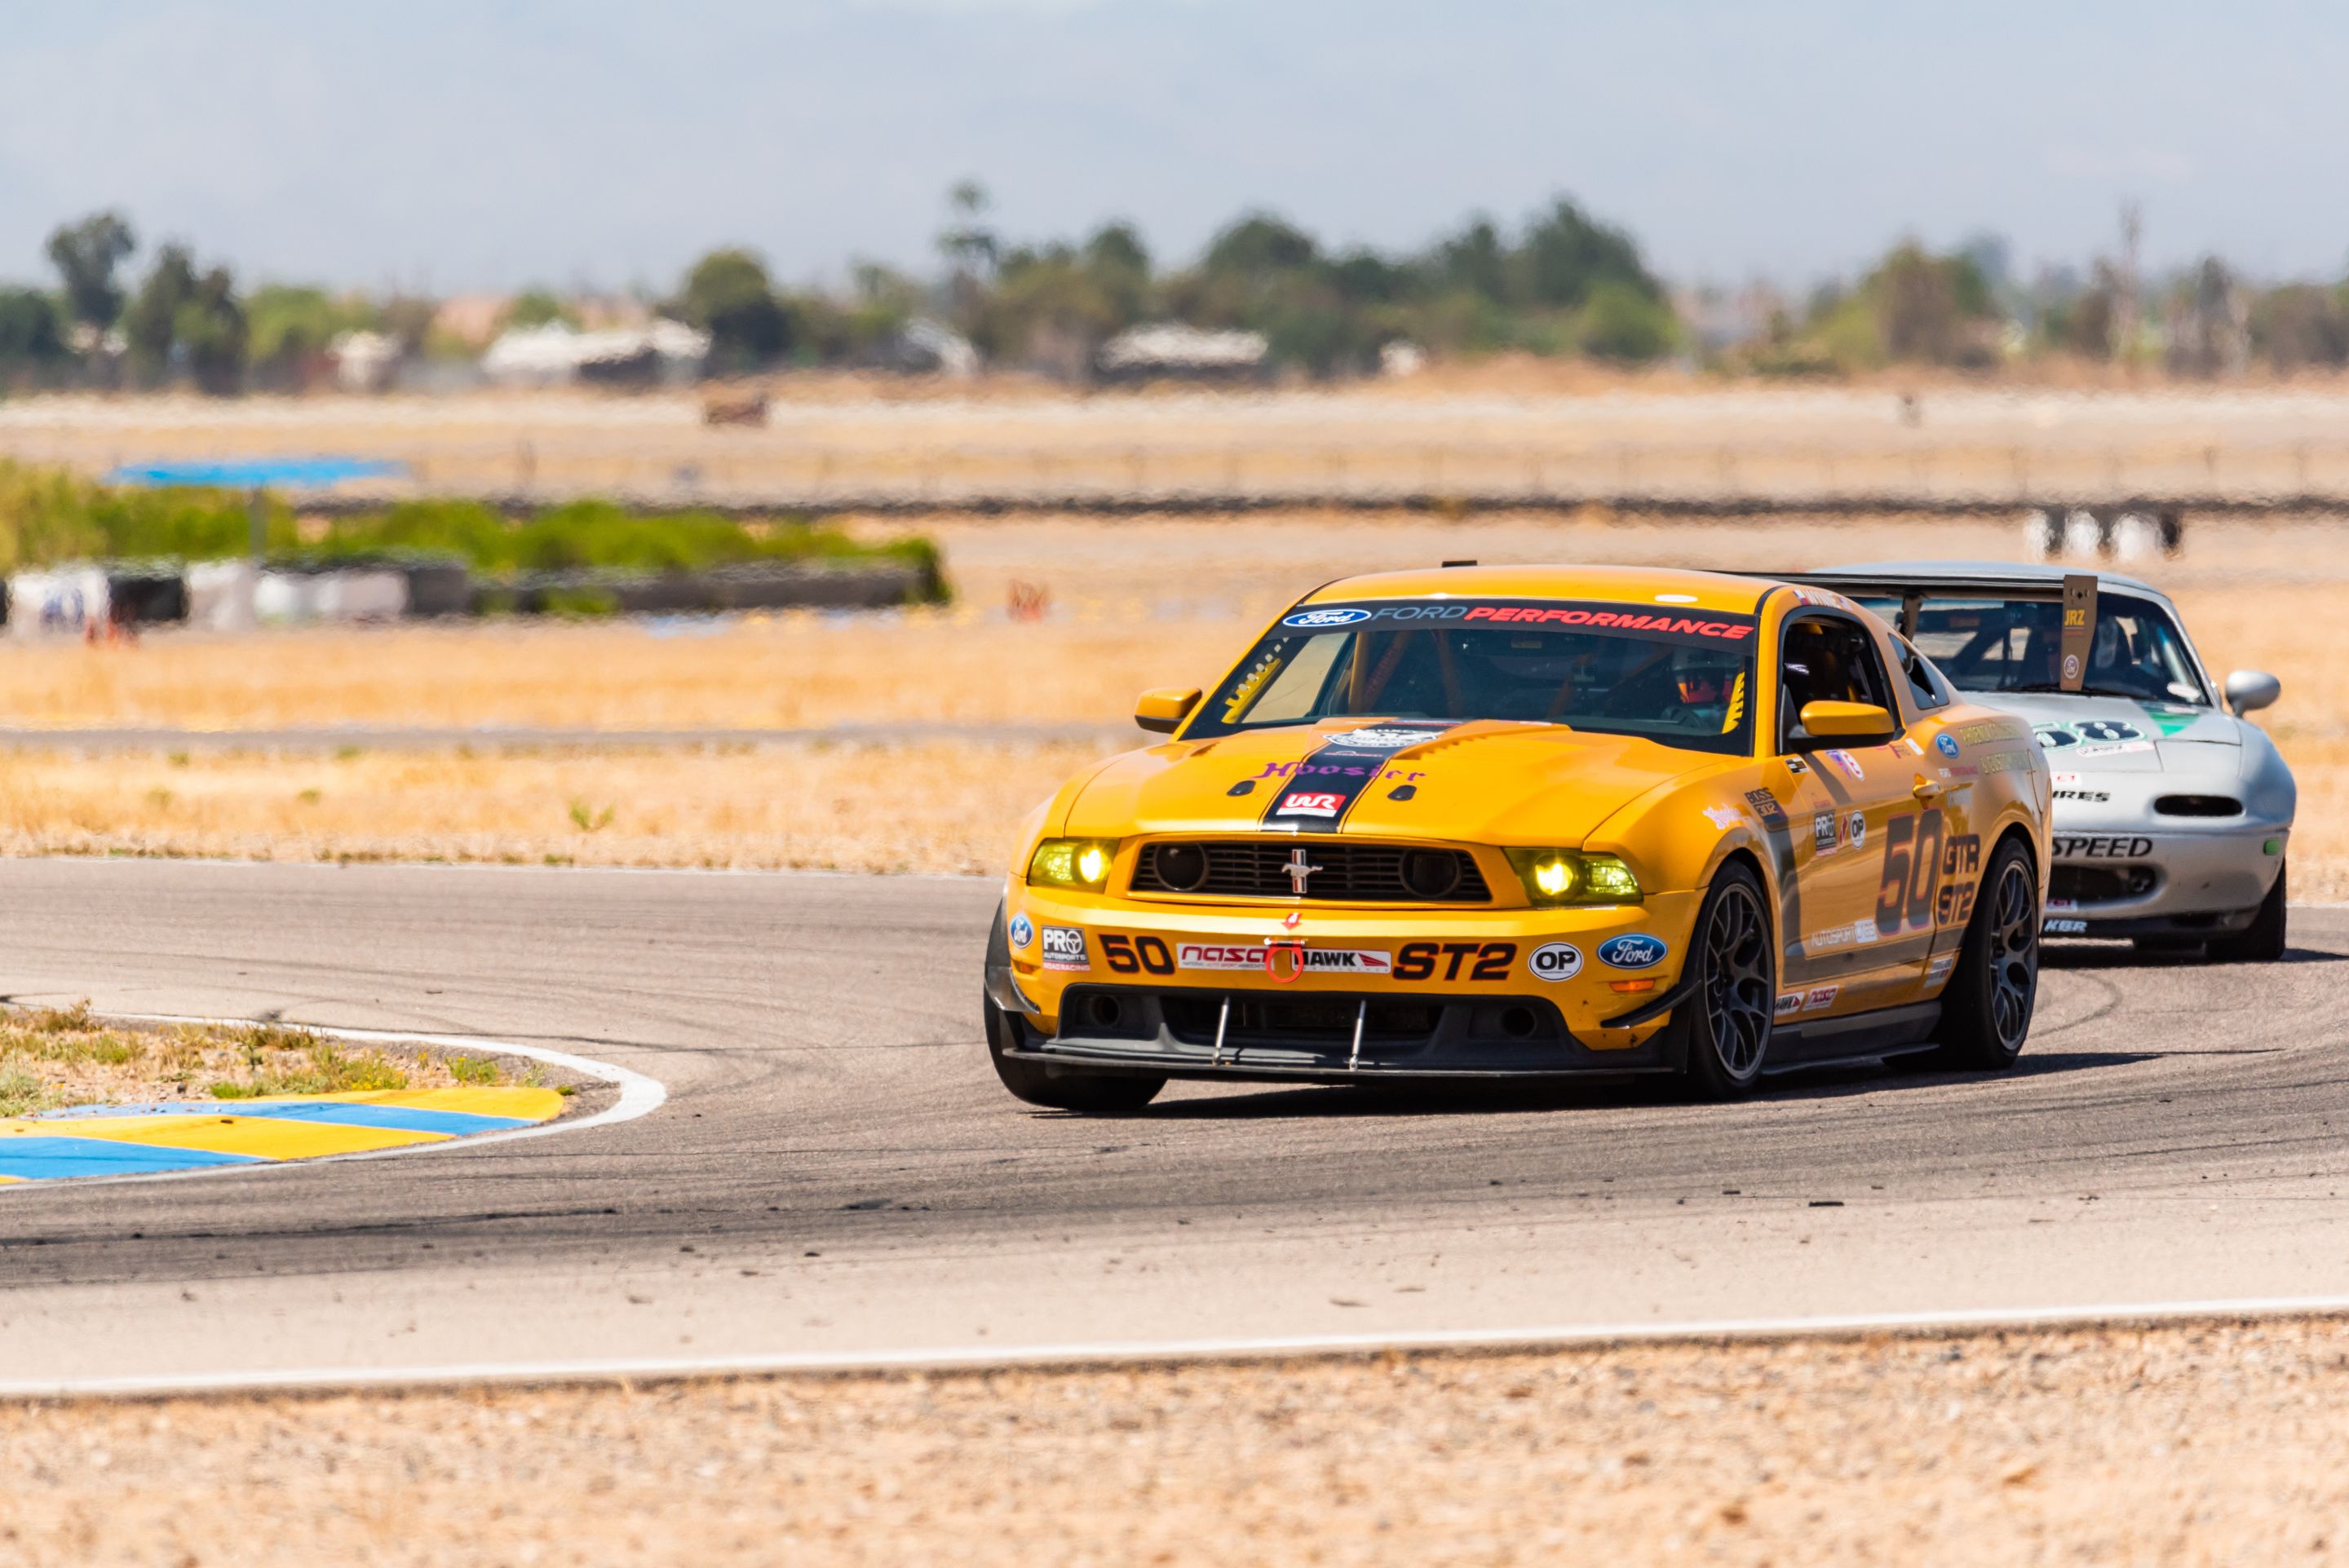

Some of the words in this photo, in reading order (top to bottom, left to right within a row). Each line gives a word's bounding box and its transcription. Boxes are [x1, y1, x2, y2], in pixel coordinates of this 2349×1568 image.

[1298, 611, 1356, 625] Ford
[2064, 609, 2085, 626] JRZ
[1745, 787, 1774, 803] BOSS
[1756, 802, 1779, 816] 302
[1852, 819, 1864, 838] OP
[2052, 837, 2152, 858] SPEED
[1876, 807, 1943, 936] 50
[1938, 881, 1975, 925] ST2
[1043, 929, 1083, 954] PRO
[1612, 939, 1654, 964] Ford
[1098, 934, 1175, 974] 50
[1182, 946, 1269, 963] nasa
[1392, 942, 1517, 982] ST2
[1535, 951, 1576, 970] OP
